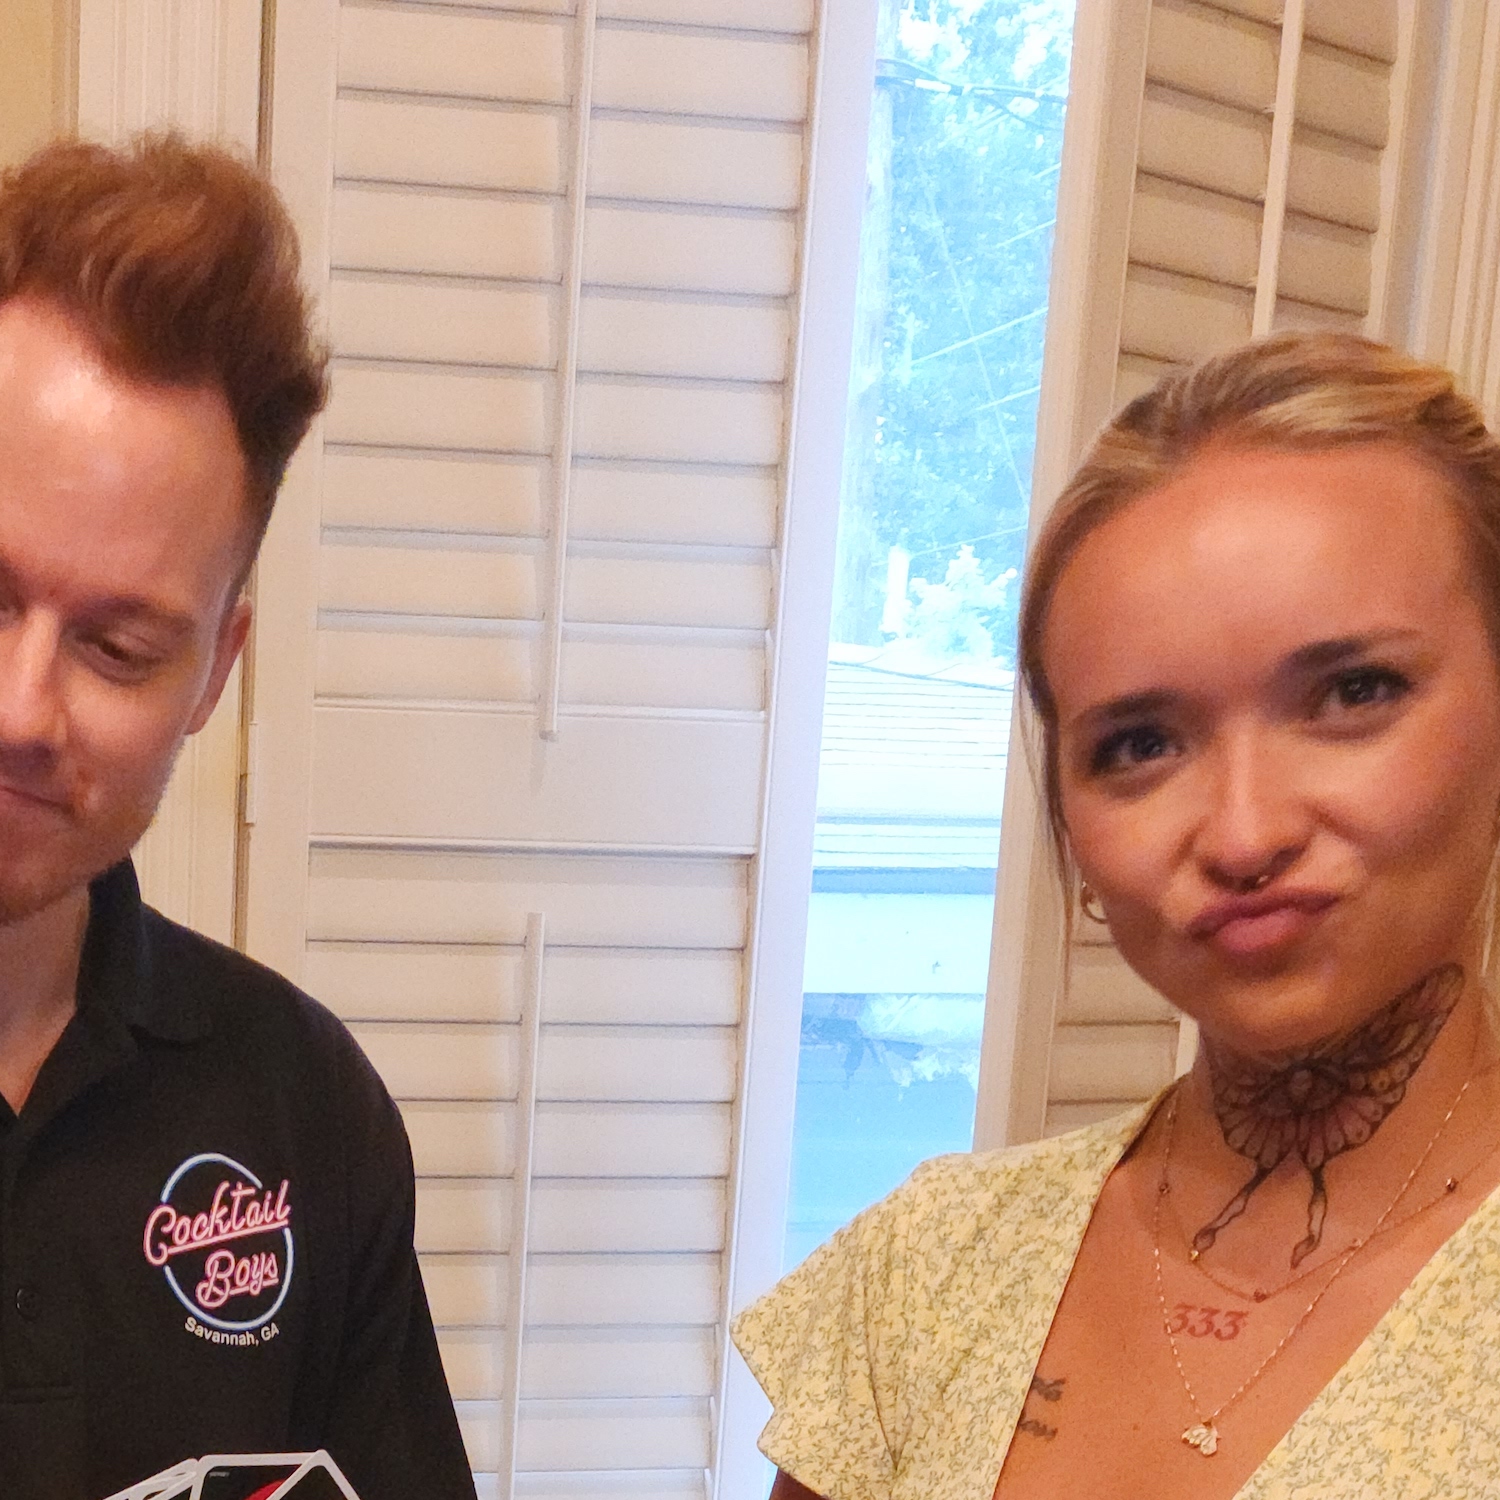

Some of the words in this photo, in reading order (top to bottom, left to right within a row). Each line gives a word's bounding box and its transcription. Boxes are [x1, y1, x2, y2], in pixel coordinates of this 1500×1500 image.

[143, 1179, 291, 1266] Cocktail
[195, 1249, 280, 1308] Boys
[184, 1316, 259, 1346] Savannah,
[261, 1322, 280, 1341] GA
